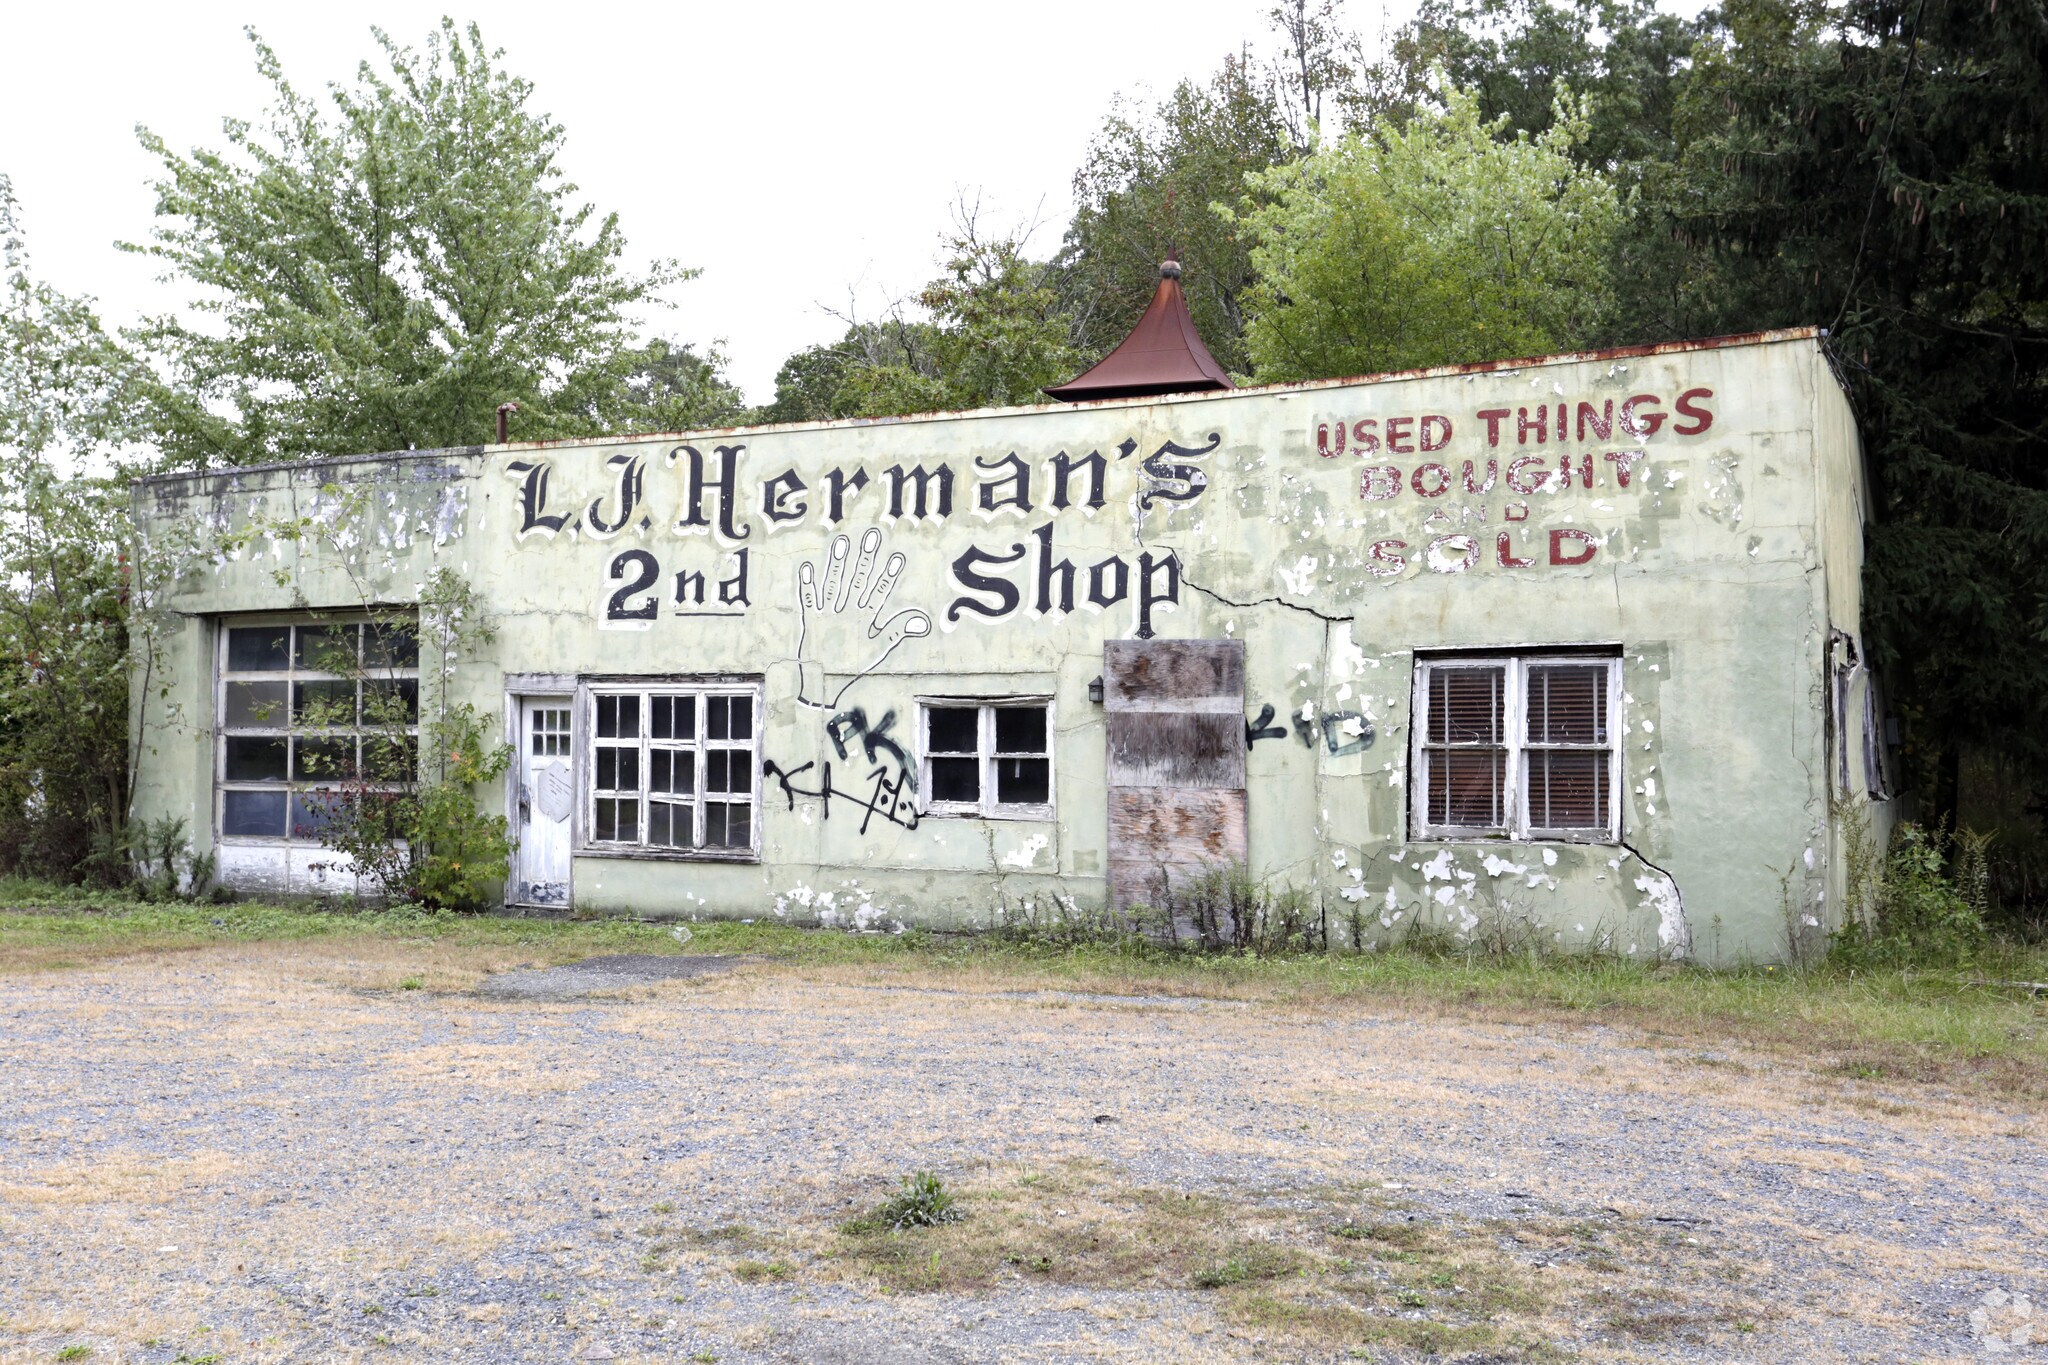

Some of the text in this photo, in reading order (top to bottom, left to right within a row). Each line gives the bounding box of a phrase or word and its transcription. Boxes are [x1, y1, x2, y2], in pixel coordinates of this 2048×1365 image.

[1316, 387, 1715, 459] USED THINGS
[668, 431, 1221, 540] Herman's
[1359, 450, 1646, 502] BOUGHT
[1423, 500, 1530, 528] AND
[607, 520, 1183, 640] 2nd Shop
[1364, 528, 1598, 578] SOLD
